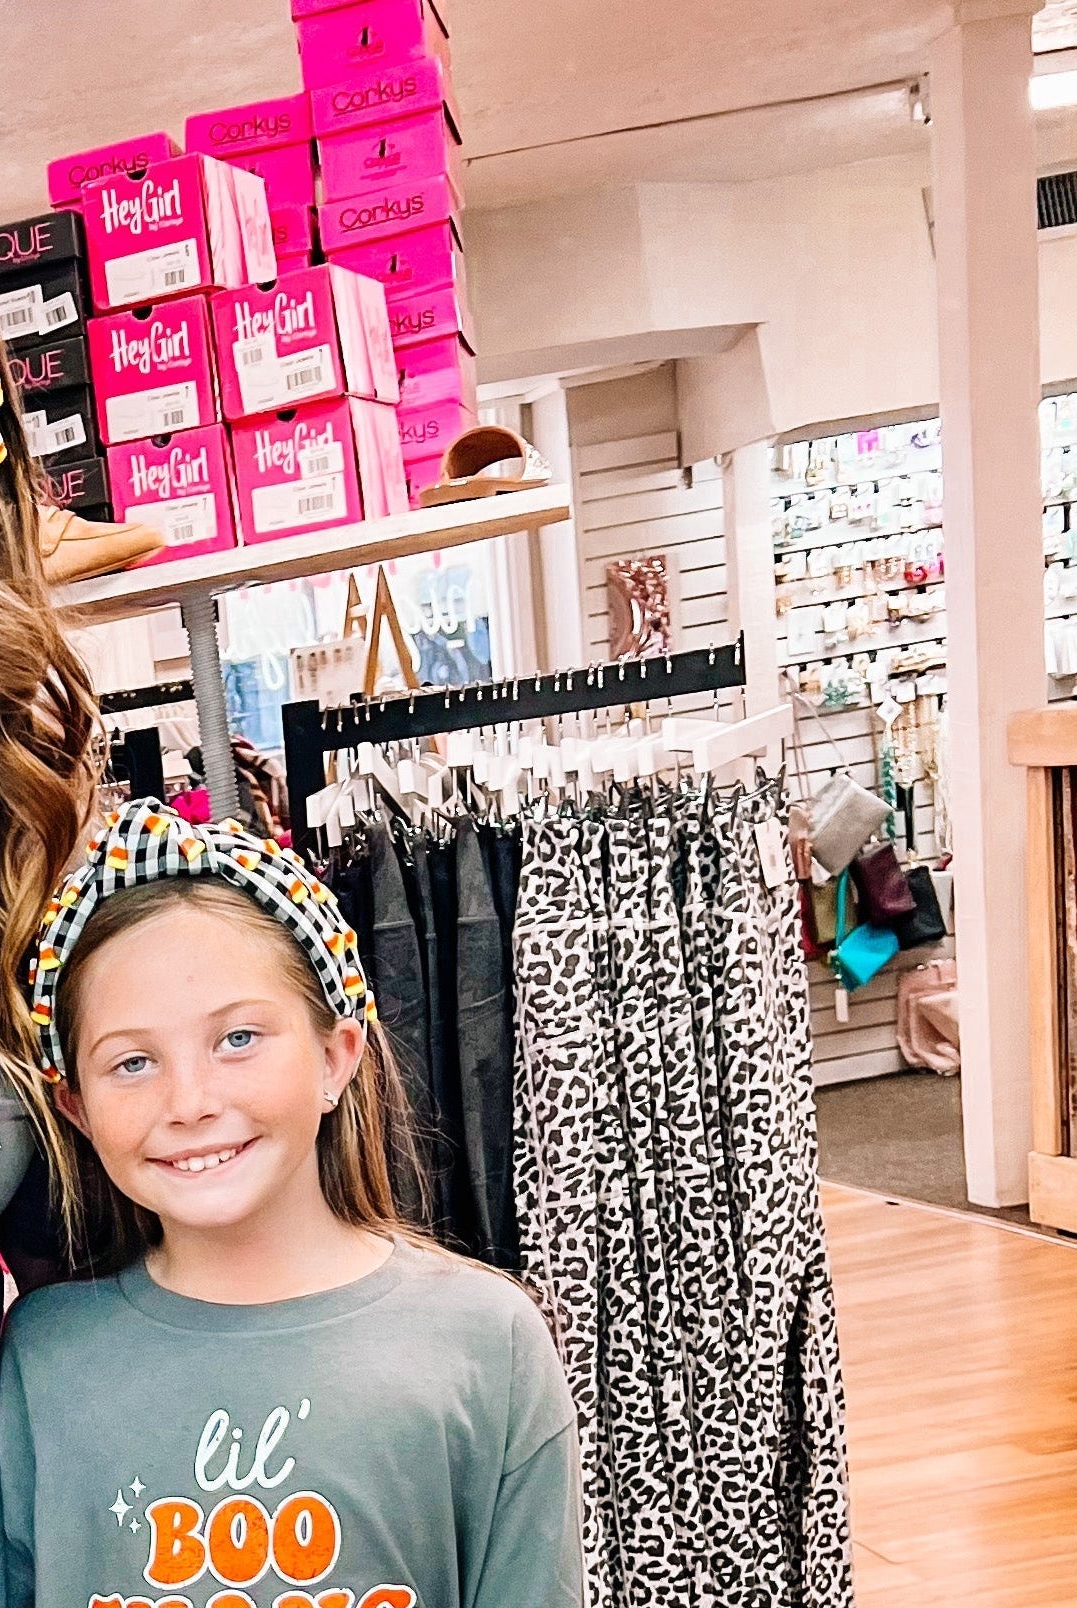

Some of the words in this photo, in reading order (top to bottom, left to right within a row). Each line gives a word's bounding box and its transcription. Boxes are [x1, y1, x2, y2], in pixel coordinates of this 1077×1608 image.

[333, 77, 417, 112] Corkys
[209, 111, 291, 143] Corkys
[69, 151, 149, 185] Corkys
[339, 194, 424, 229] Corkys
[389, 309, 435, 334] kys
[399, 420, 440, 444] kys
[142, 1490, 342, 1590] BOO
